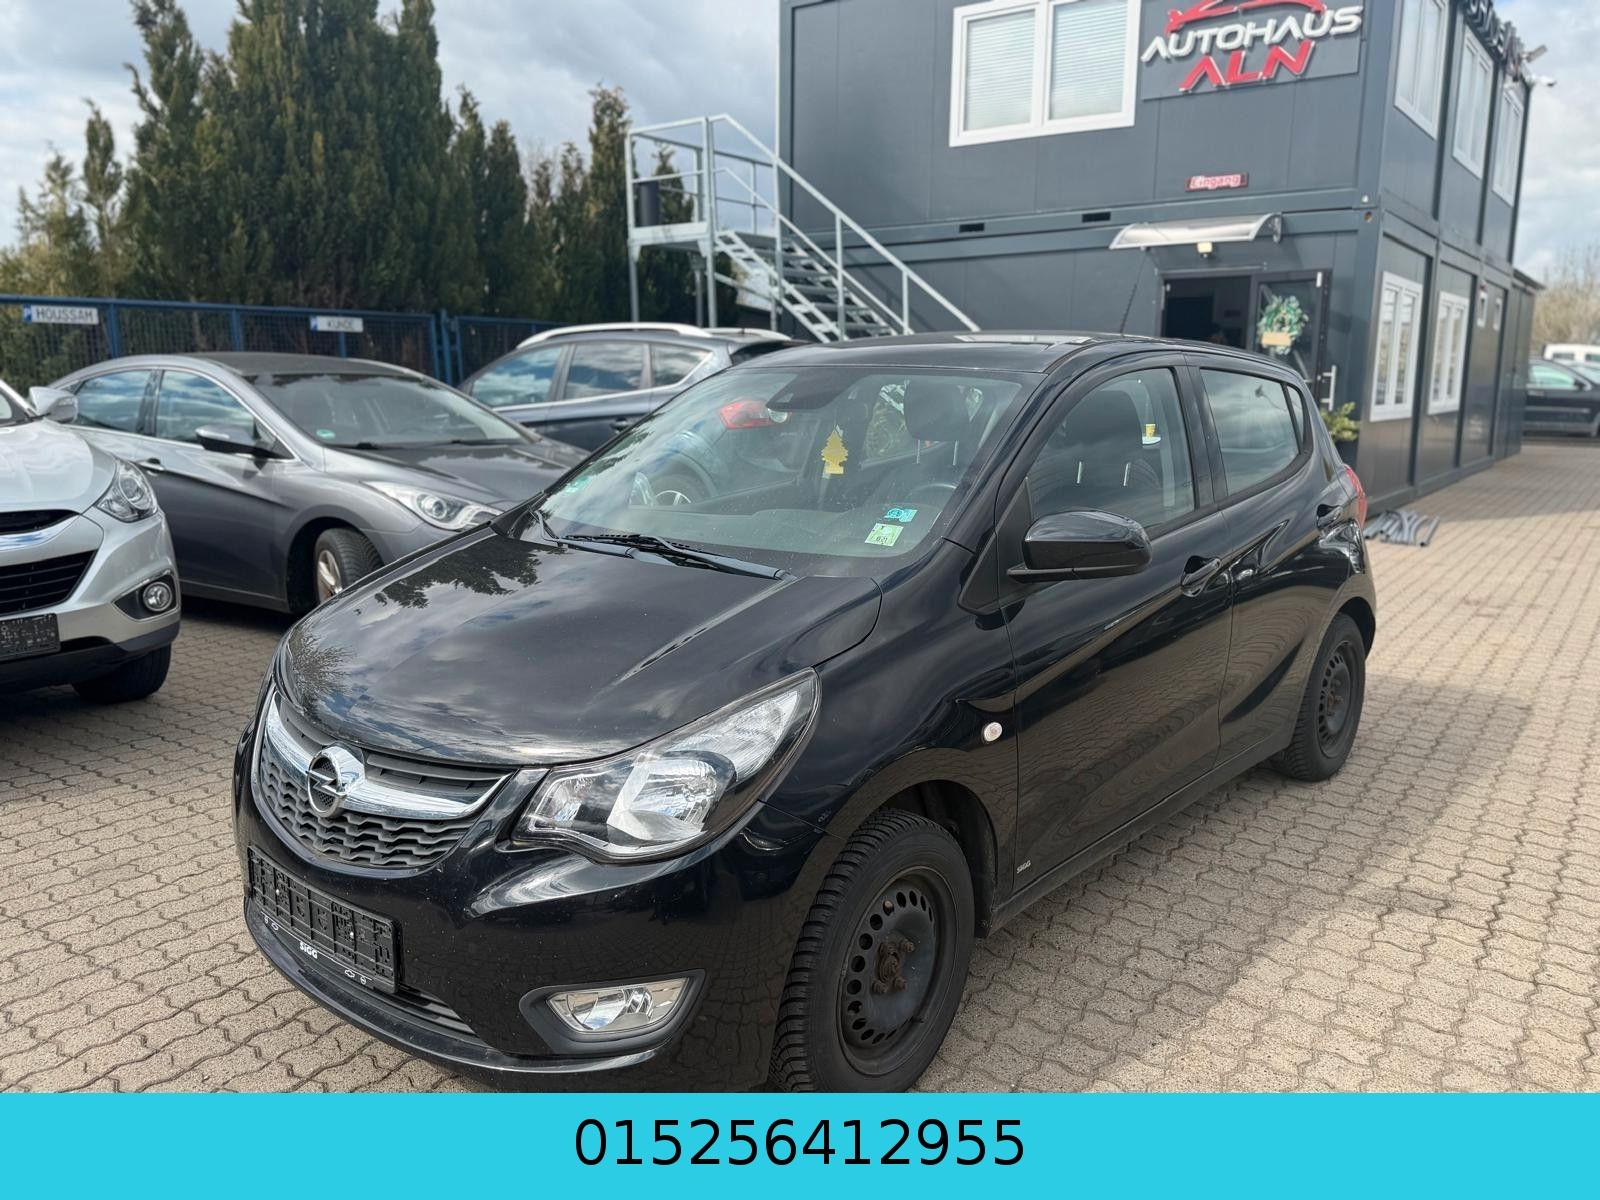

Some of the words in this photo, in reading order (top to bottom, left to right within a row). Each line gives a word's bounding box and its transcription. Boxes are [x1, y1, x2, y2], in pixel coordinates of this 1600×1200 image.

[1140, 5, 1364, 62] AUTOHAUS
[1178, 39, 1315, 92] ALN
[1190, 174, 1242, 190] Eingang
[35, 306, 94, 322] HOUSSAM
